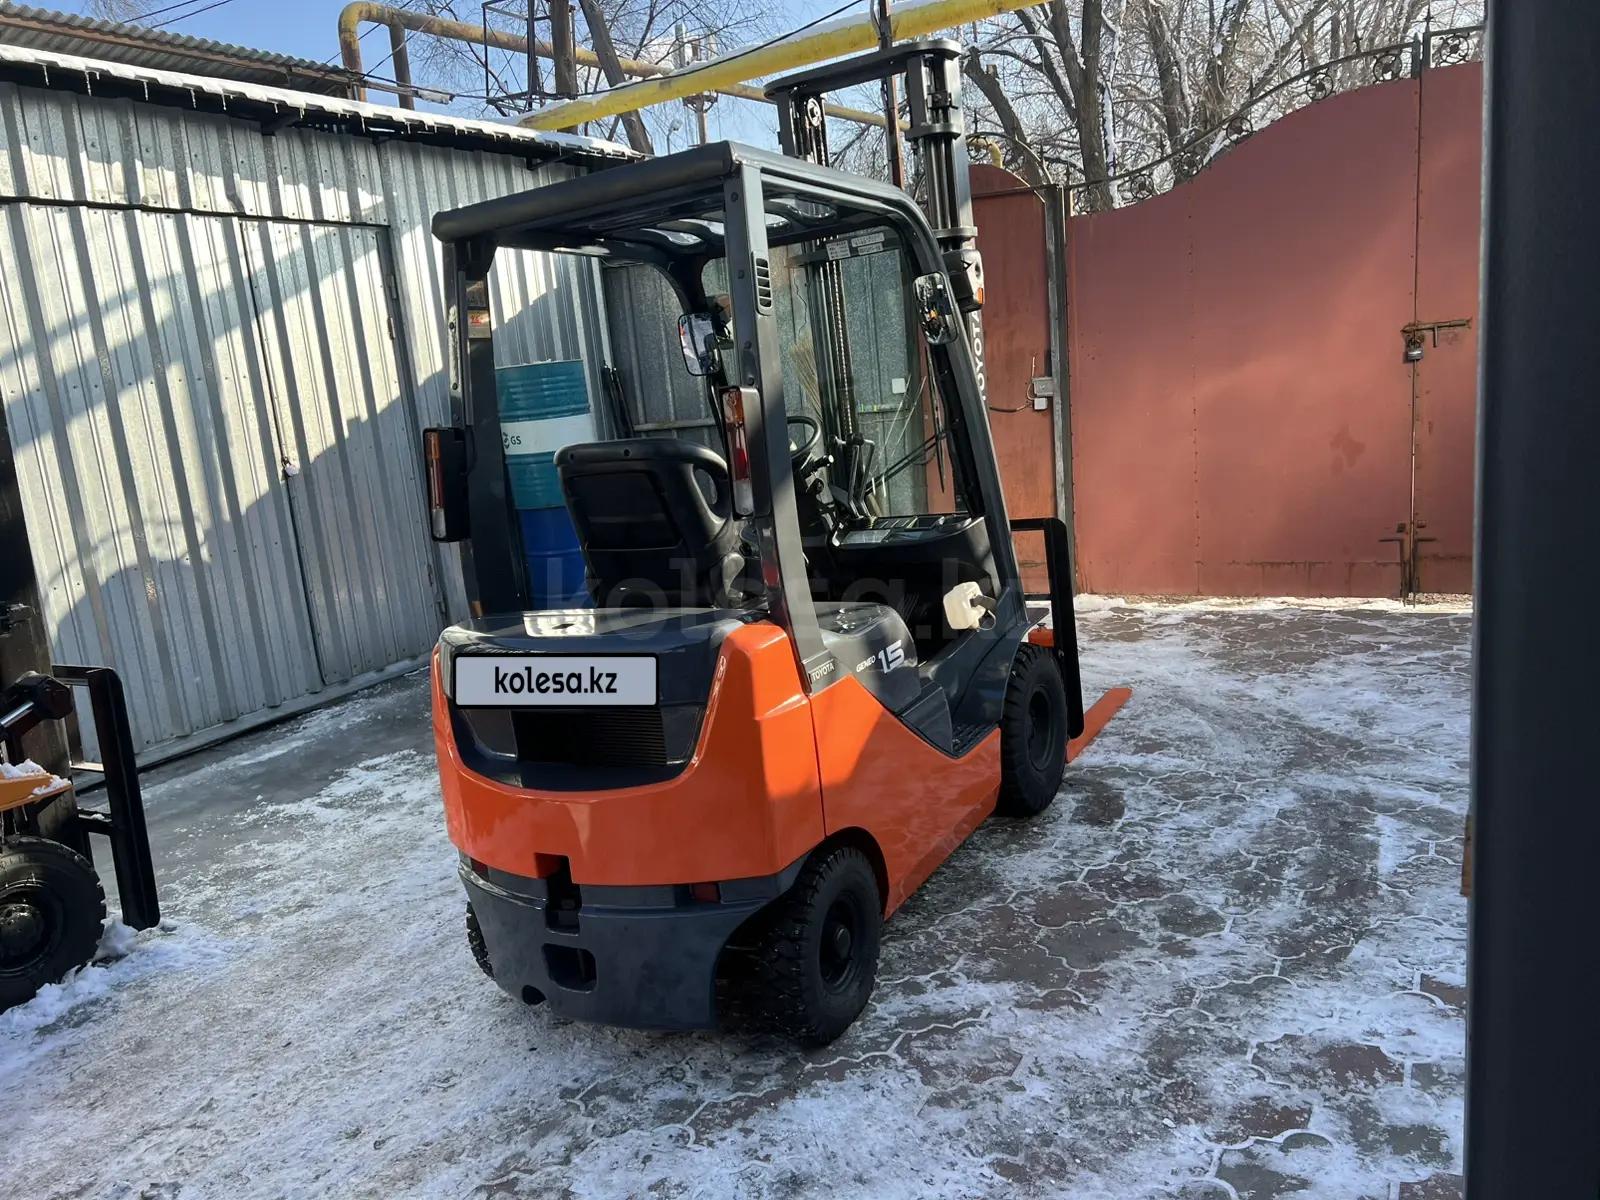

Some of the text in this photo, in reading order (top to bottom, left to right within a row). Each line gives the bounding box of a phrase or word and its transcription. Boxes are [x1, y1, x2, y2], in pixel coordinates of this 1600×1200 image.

[971, 310, 987, 401] OYOTA
[510, 435, 522, 445] GS
[811, 662, 835, 681] TOYOTA
[856, 655, 876, 672] GENEO
